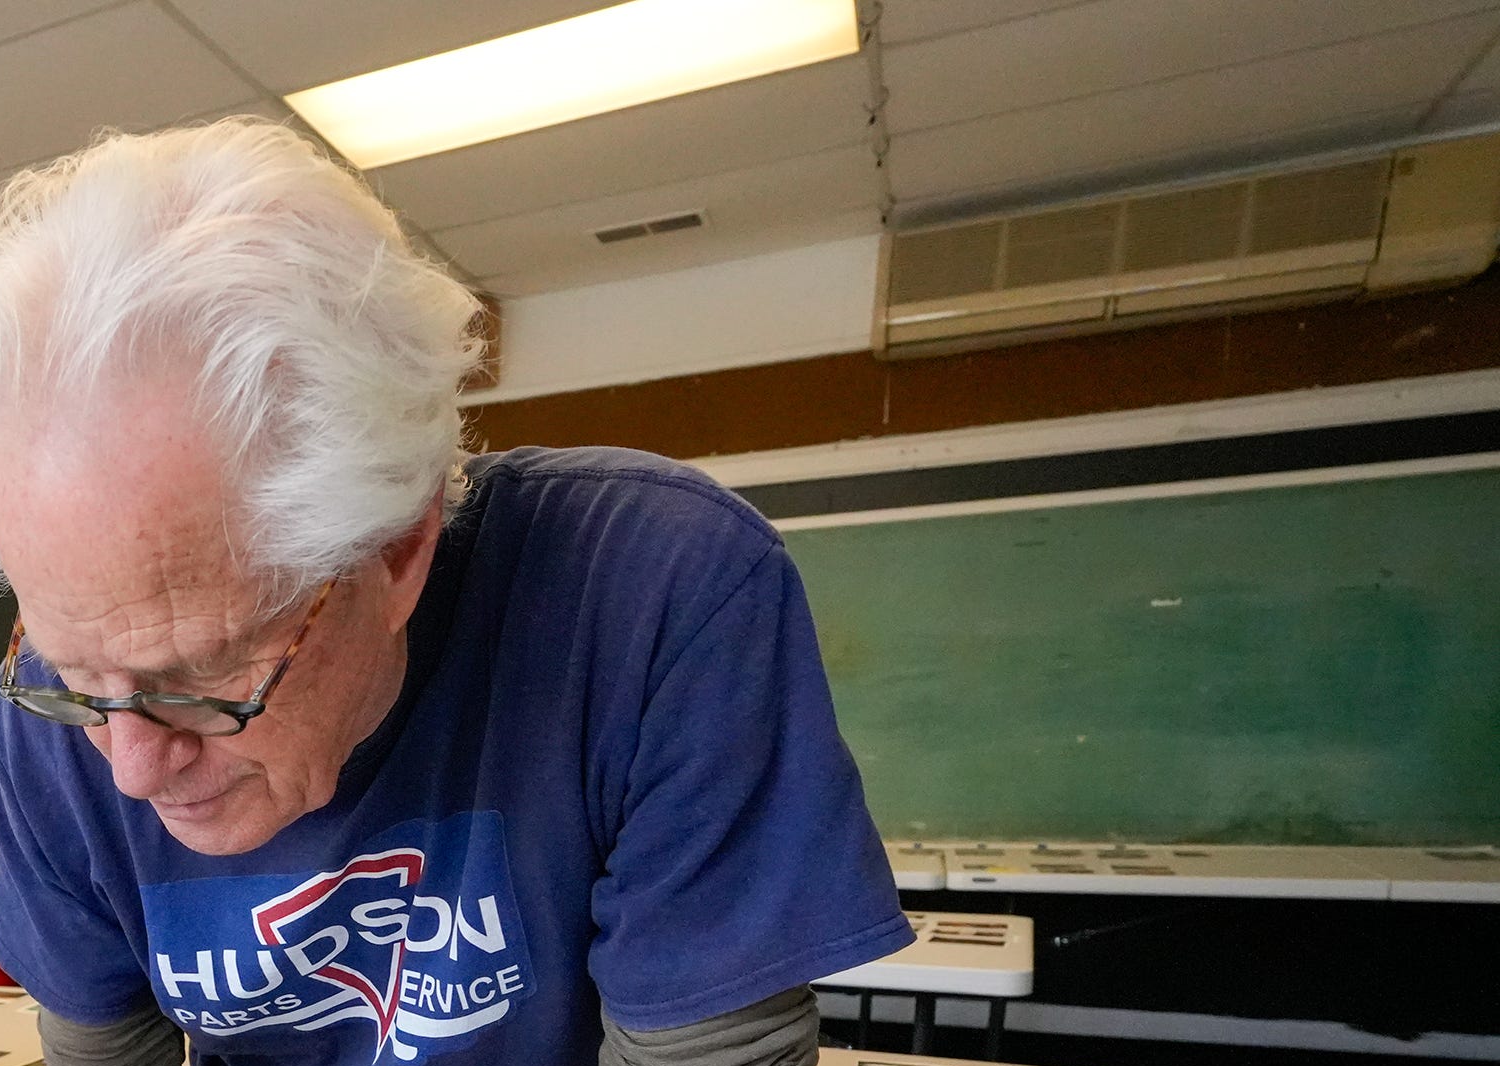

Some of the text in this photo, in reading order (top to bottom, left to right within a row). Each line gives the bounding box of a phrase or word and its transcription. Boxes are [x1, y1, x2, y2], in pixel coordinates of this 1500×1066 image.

[156, 895, 506, 1000] HUDSON
[173, 965, 524, 1029] PARTS ERVICE
